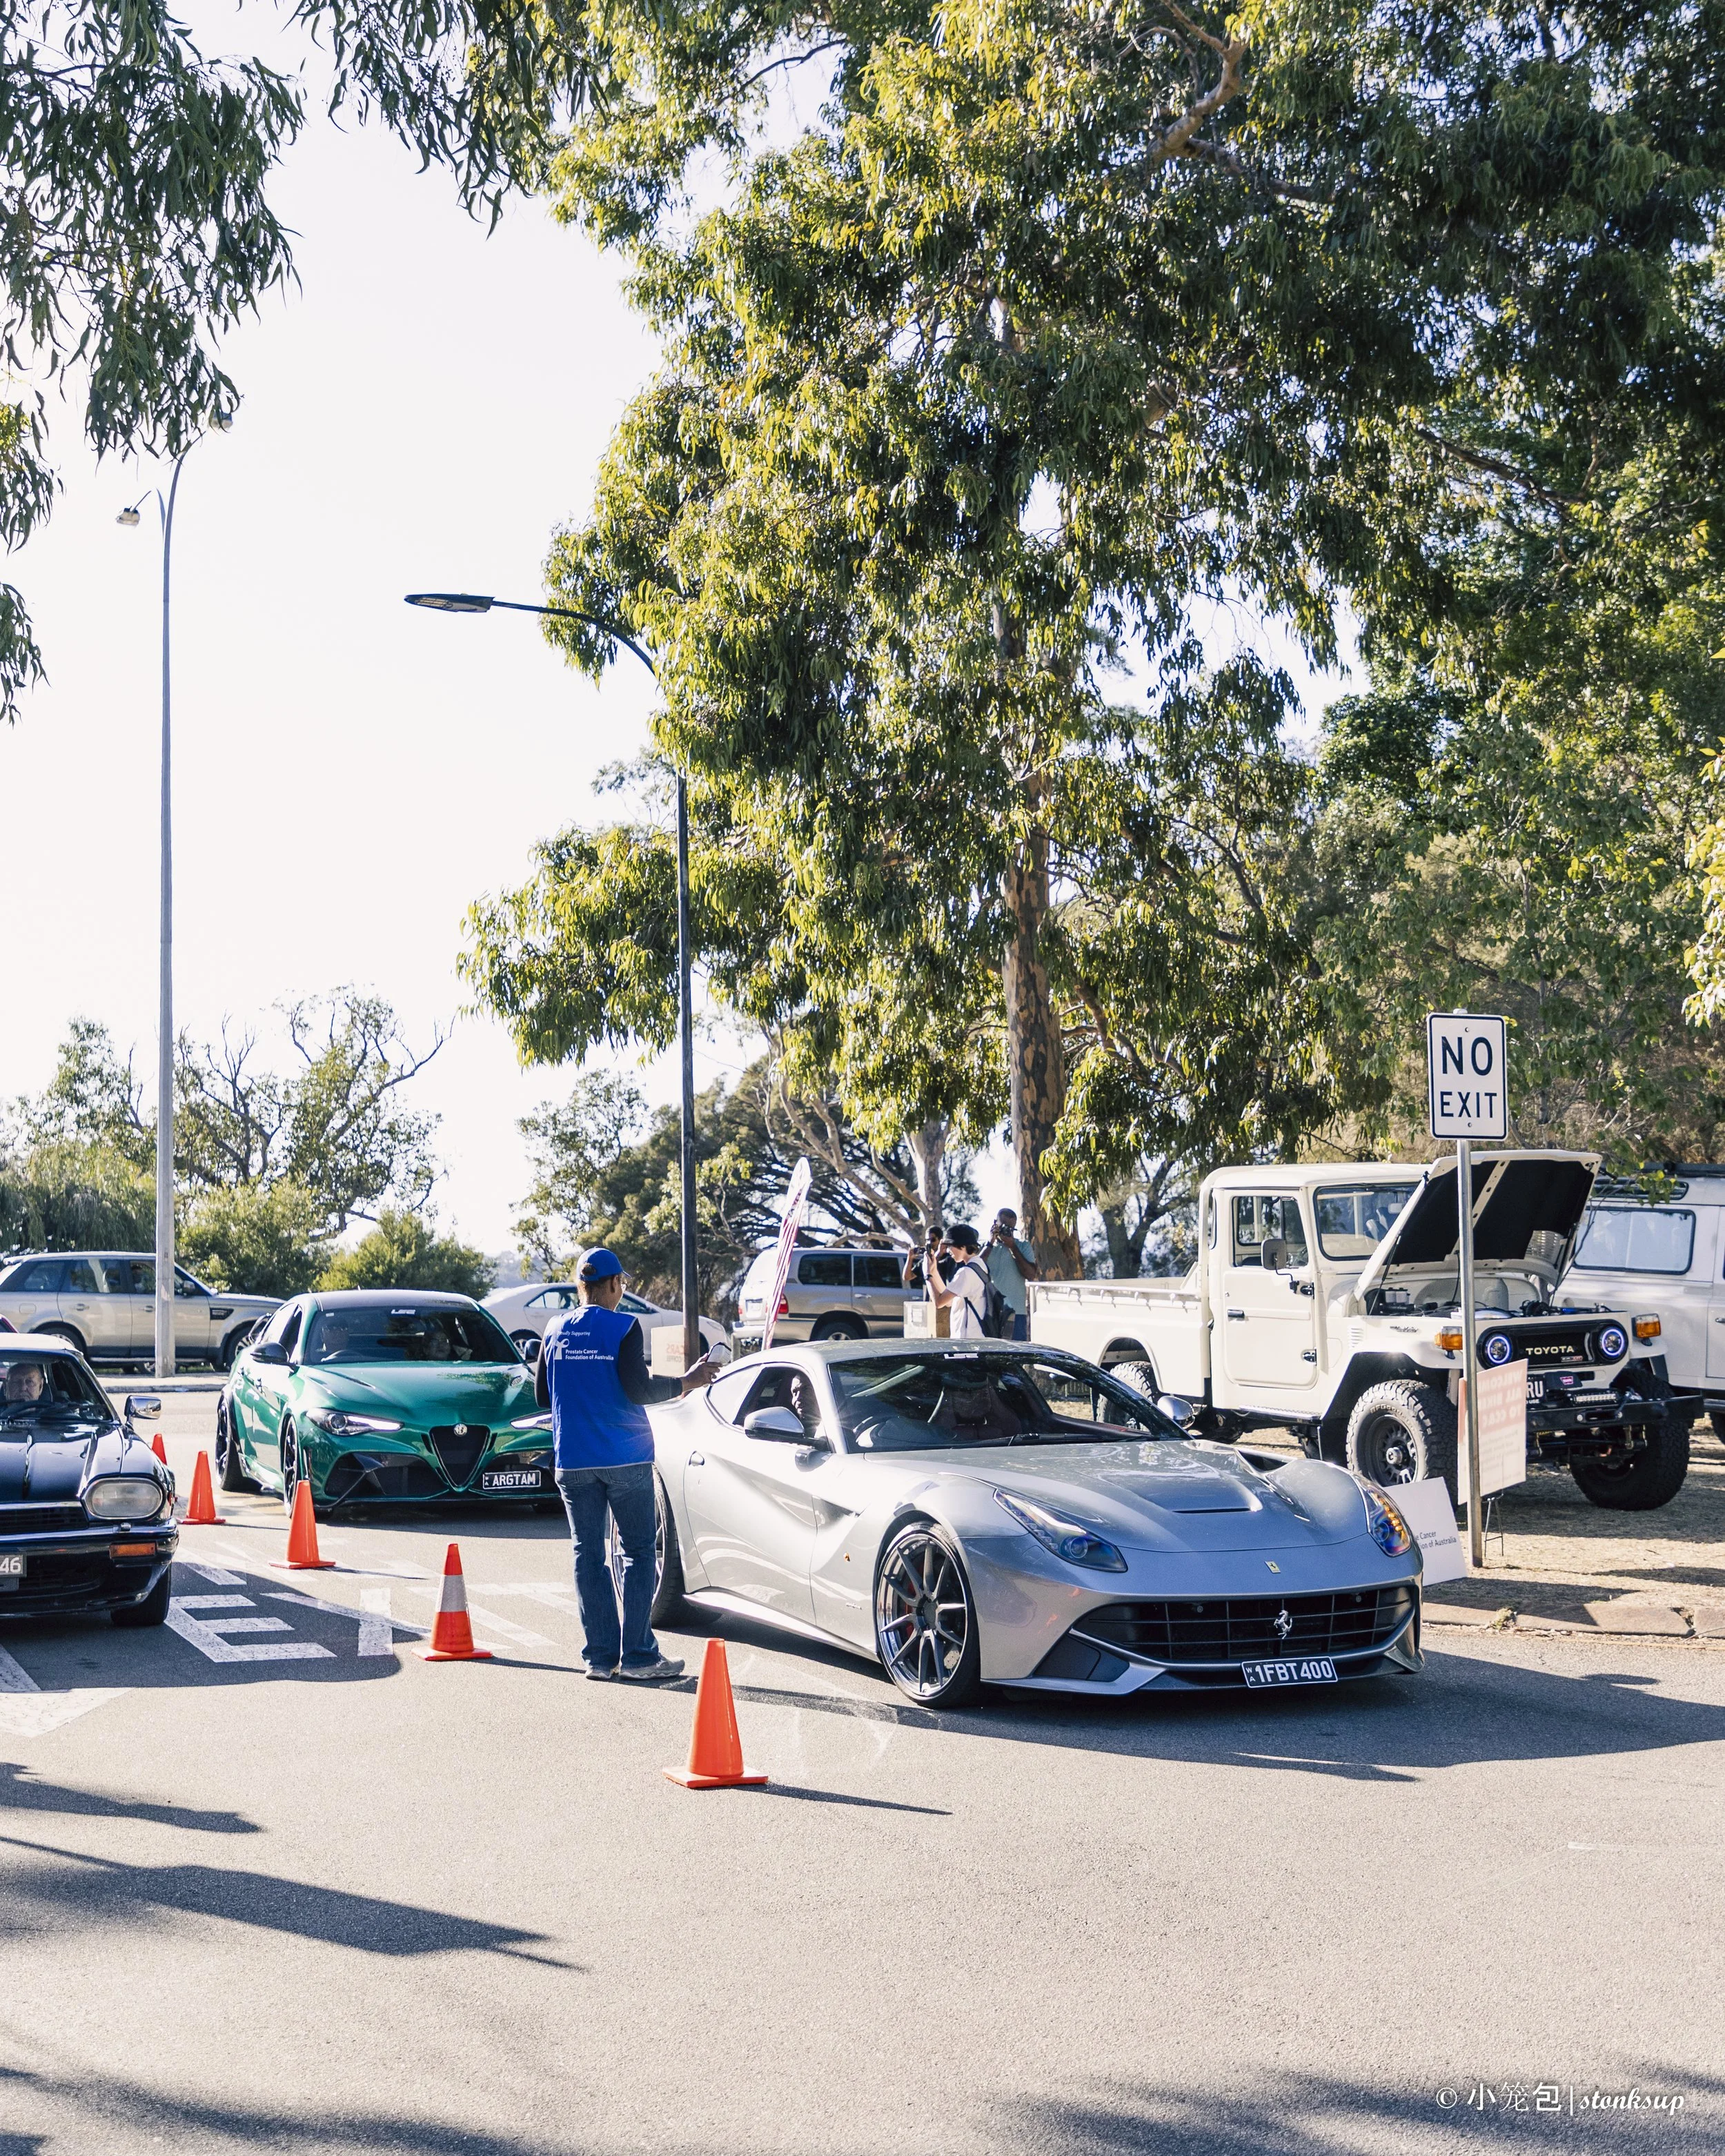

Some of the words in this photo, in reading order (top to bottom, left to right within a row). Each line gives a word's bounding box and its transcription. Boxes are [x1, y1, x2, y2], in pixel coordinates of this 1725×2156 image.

[1441, 1036, 1492, 1076] NO
[1440, 1091, 1497, 1118] EXIT
[1525, 1345, 1575, 1356] TOYOTA
[492, 1473, 536, 1486] ARGTAM
[1419, 1531, 1437, 1540] Cancer
[1435, 1536, 1457, 1547] Australia
